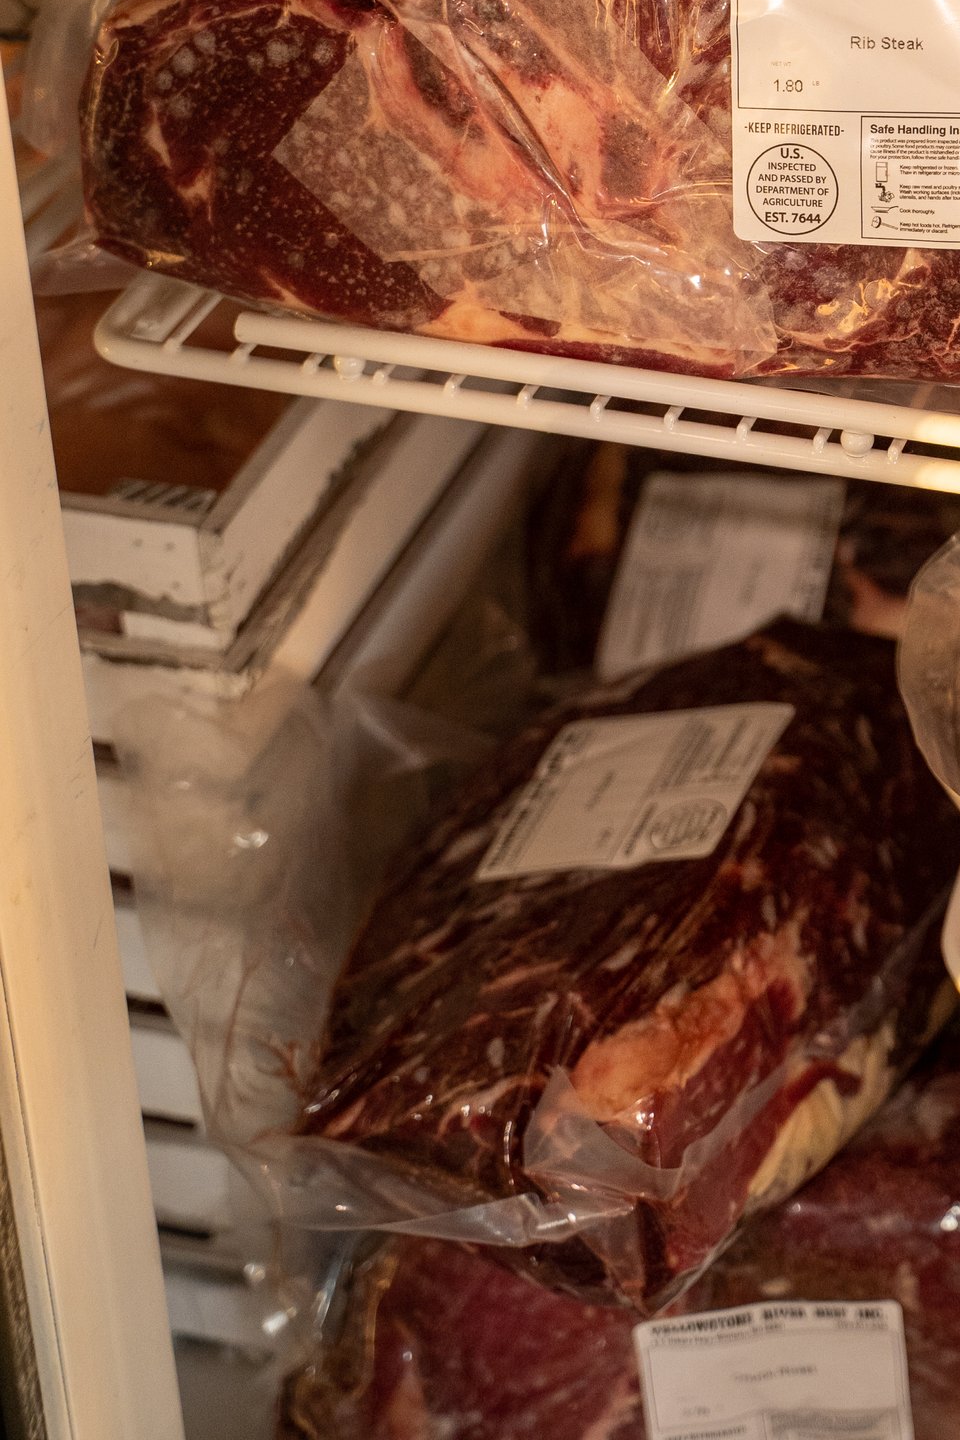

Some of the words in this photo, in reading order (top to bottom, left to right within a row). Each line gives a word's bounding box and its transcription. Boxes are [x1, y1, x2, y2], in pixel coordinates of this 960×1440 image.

[850, 35, 876, 50] Rib
[881, 36, 924, 51] Steak
[773, 78, 804, 93] 1.80
[744, 121, 772, 134] -KEEP
[774, 122, 845, 137] REFRIGERATED-
[870, 123, 895, 135] Safe
[897, 124, 947, 137] Handling
[780, 147, 804, 160] U.S.
[768, 161, 817, 172] INSPECTED
[757, 173, 778, 182] AND
[779, 174, 814, 184] PASSED
[815, 175, 827, 184] BY
[755, 185, 816, 196] DEPARTMENT
[816, 187, 830, 196] OF
[762, 197, 823, 208] AGRICULTURE
[764, 211, 789, 223] EST.
[791, 212, 822, 224] 7644
